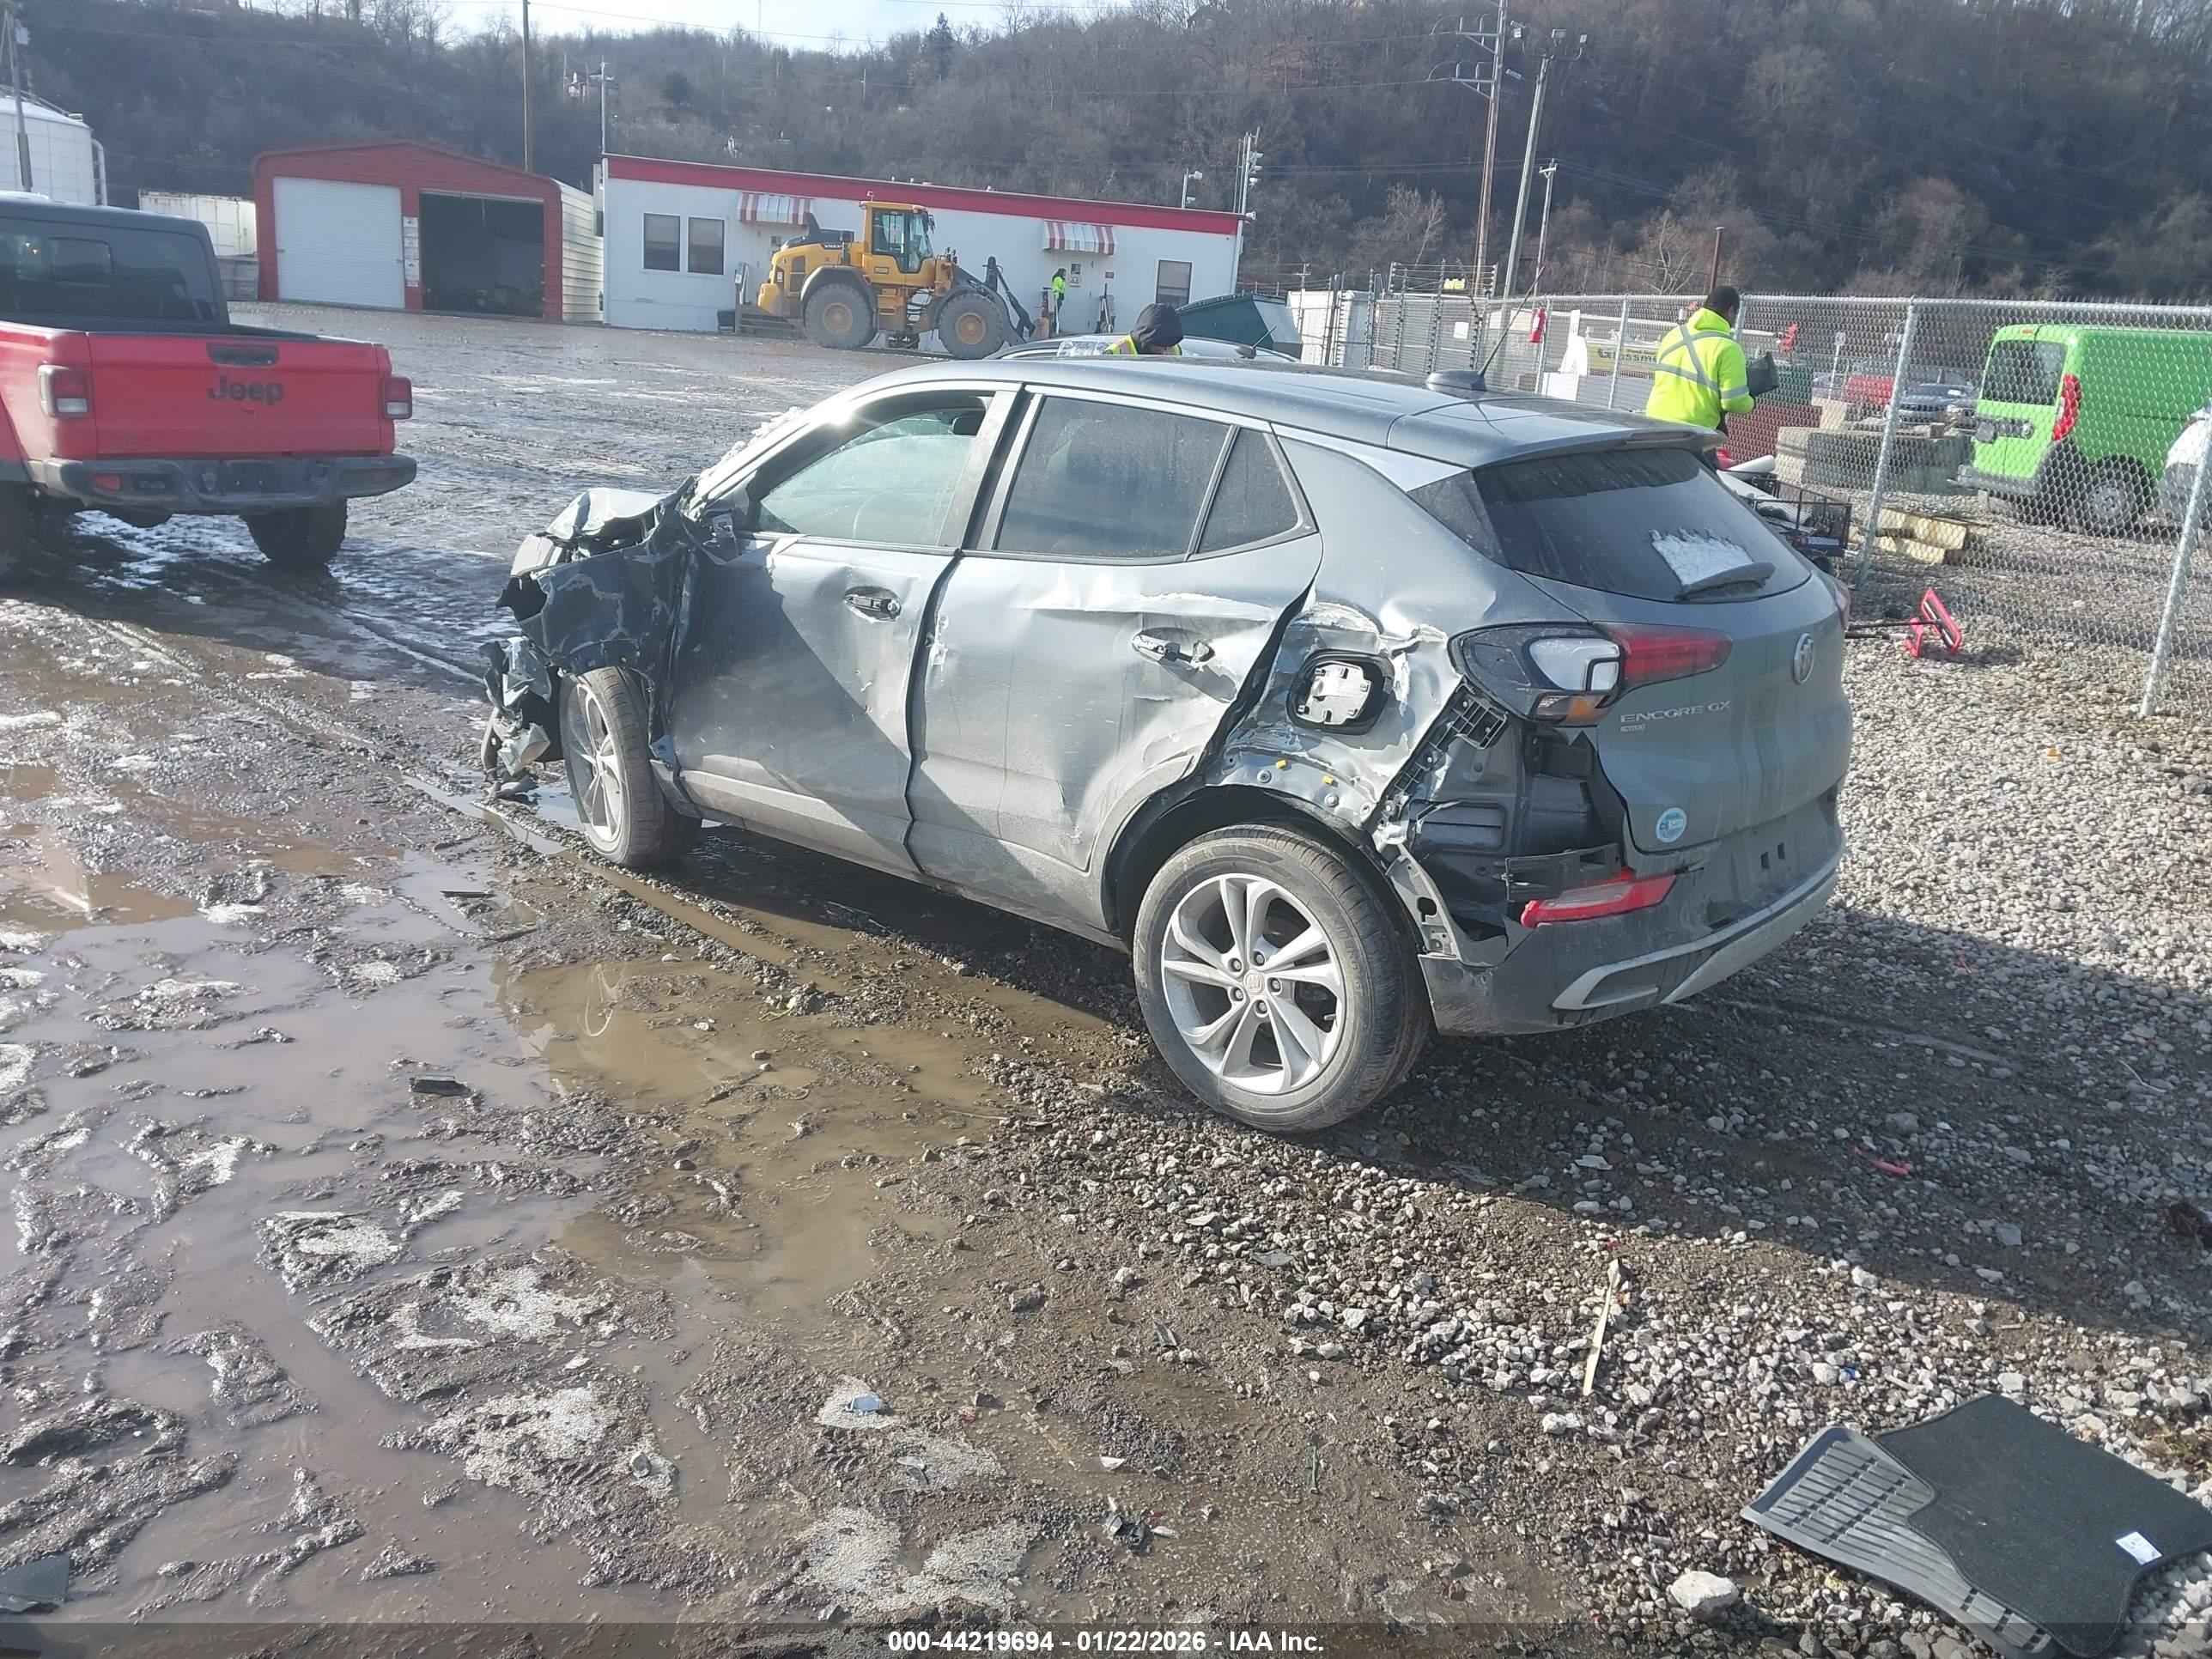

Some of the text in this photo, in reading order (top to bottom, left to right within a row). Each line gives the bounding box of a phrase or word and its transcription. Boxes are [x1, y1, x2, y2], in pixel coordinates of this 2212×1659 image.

[207, 374, 284, 406] Jeep
[1620, 700, 1731, 723] ENCORE GX
